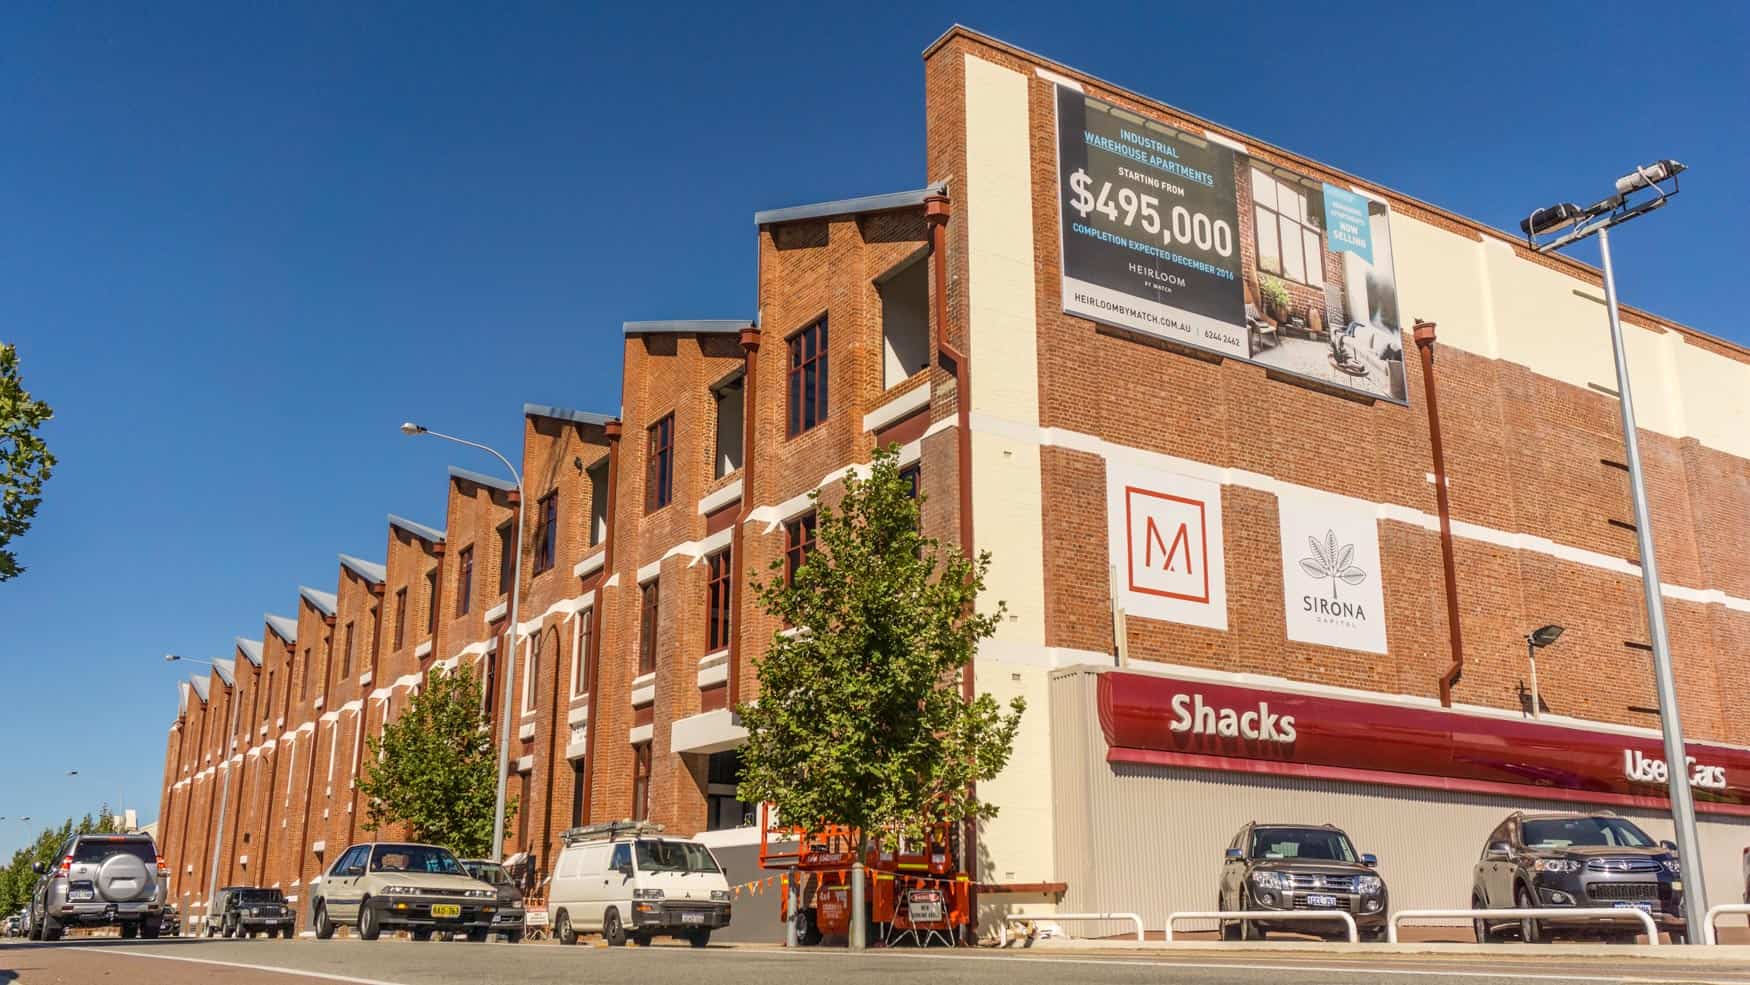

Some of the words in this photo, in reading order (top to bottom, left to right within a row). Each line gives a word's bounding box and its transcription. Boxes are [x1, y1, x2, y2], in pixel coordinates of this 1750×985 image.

[1084, 131, 1149, 164] WAREHOUSE
[1150, 155, 1214, 186] APARTMENTS
[1120, 128, 1180, 159] INDUSTRIAL
[1118, 167, 1160, 189] STARTING
[1161, 180, 1185, 197] FROM
[1069, 168, 1233, 258] $495,000
[1072, 223, 1127, 248] COMPLETION
[1128, 240, 1171, 261] EXPECTED
[1172, 251, 1216, 275] DECEMBER
[1216, 267, 1234, 281] 2016
[1128, 262, 1186, 287] HEIRLOOM
[1074, 292, 1191, 333] HEIRLOOMBYMATCH.COM.AU
[1204, 329, 1222, 343] 6244
[1223, 334, 1241, 347] 2462
[1303, 595, 1367, 621] SIRONA
[1169, 693, 1297, 744] Shacks
